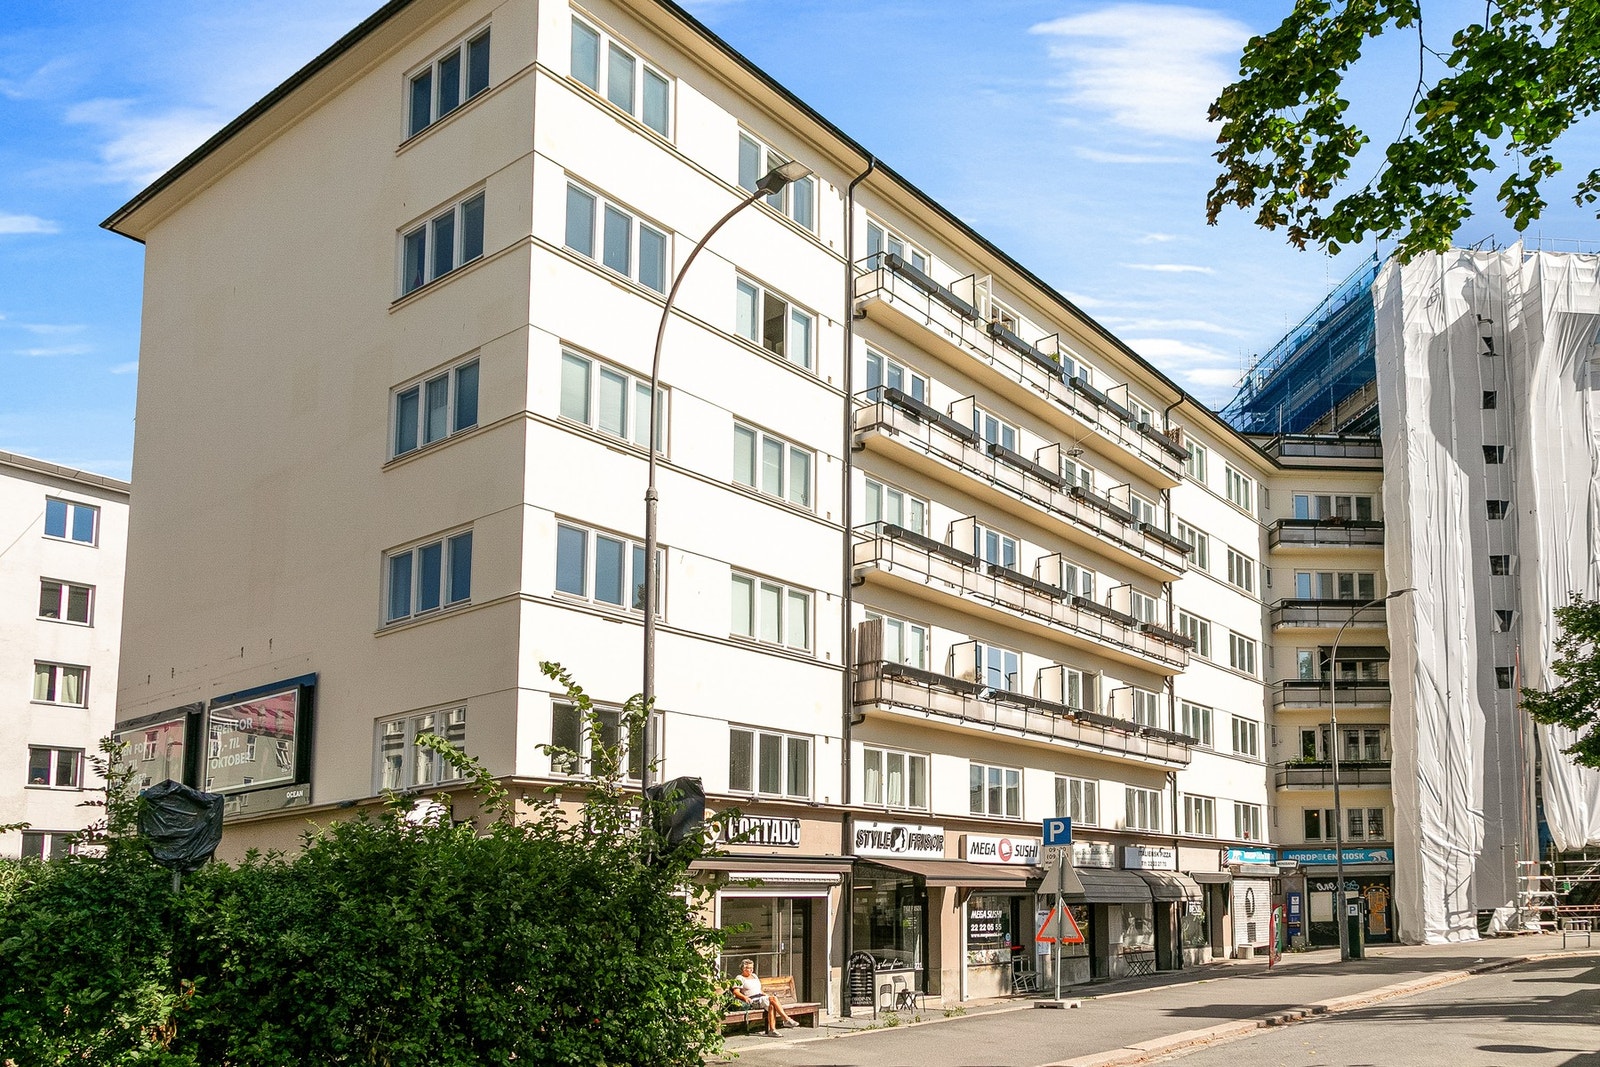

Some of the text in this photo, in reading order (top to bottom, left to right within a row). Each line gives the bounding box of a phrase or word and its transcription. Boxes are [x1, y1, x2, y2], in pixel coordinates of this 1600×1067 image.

[229, 736, 240, 749] TIL
[286, 790, 304, 798] OCEAN
[728, 816, 801, 844] CORTADO
[1049, 821, 1065, 842] P
[856, 829, 891, 849] STYLE
[970, 842, 1039, 858] MEGA SUSHI
[1342, 852, 1365, 860] KIOSK
[970, 910, 1003, 919] MEGA SUSHI
[970, 923, 979, 931] 22
[979, 923, 987, 931] 22
